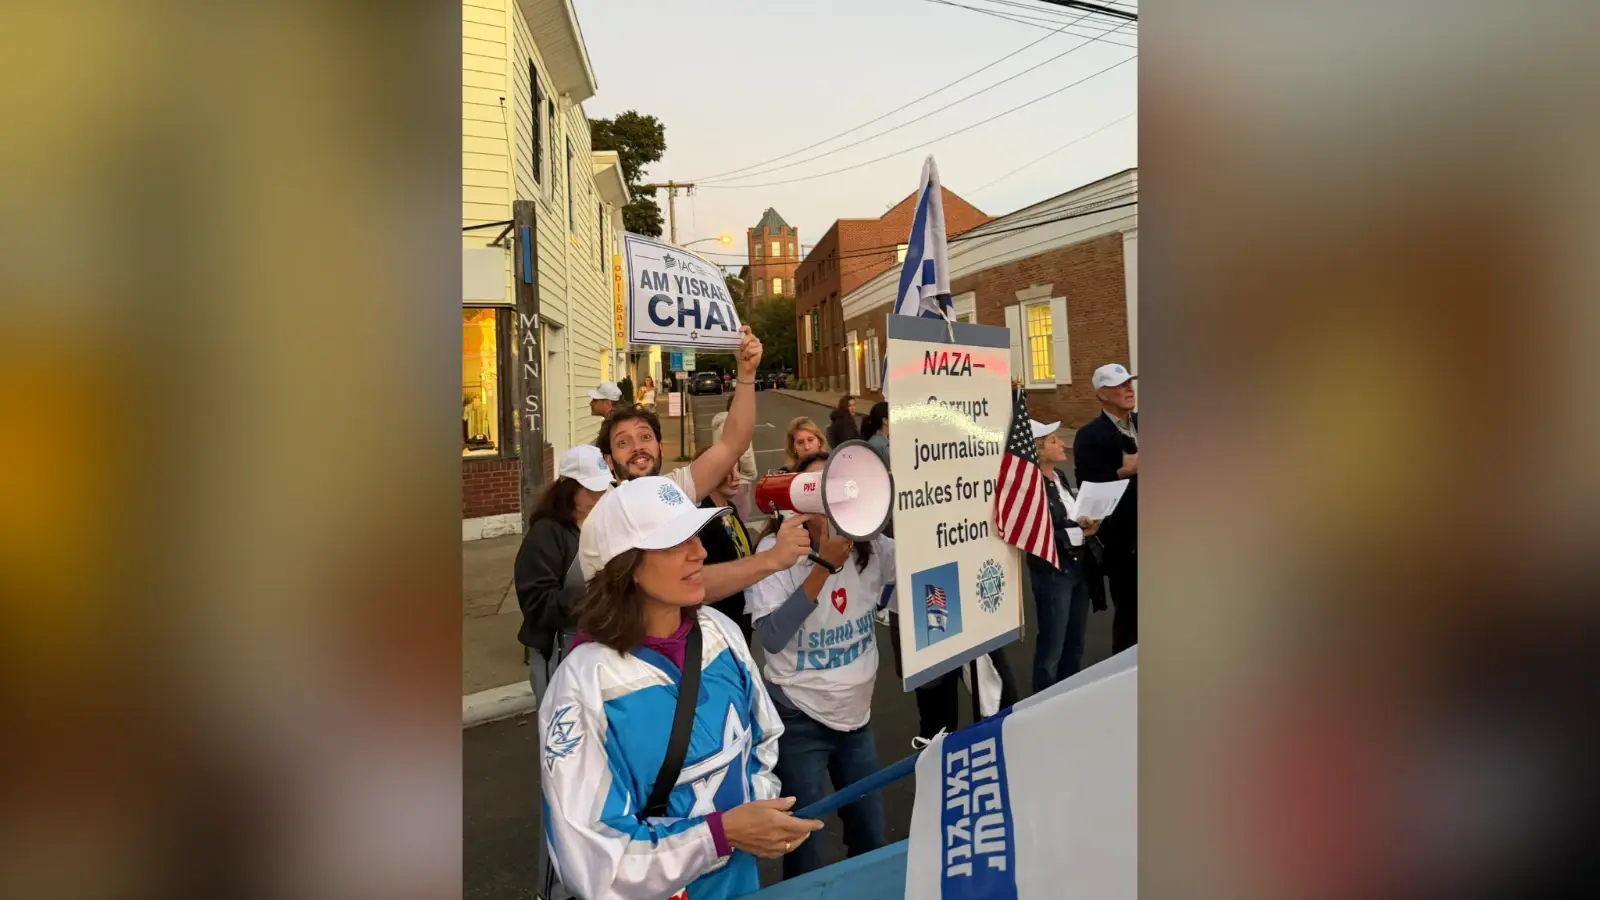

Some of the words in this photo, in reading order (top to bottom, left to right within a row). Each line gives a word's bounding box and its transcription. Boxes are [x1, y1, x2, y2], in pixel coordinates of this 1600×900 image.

[640, 269, 670, 293] AM
[678, 259, 697, 274] IAC
[614, 265, 625, 338] obligato
[647, 293, 737, 333] CHAI
[520, 313, 539, 380] MAIN
[525, 395, 541, 431] ST.
[914, 435, 1000, 470] journalism
[803, 482, 816, 492] PYLE
[898, 480, 951, 511] makes
[955, 476, 979, 501] for
[936, 518, 989, 549] fiction
[797, 629, 803, 648] I
[808, 619, 853, 648] stand
[856, 609, 877, 634] wi
[795, 634, 873, 672] ISRA
